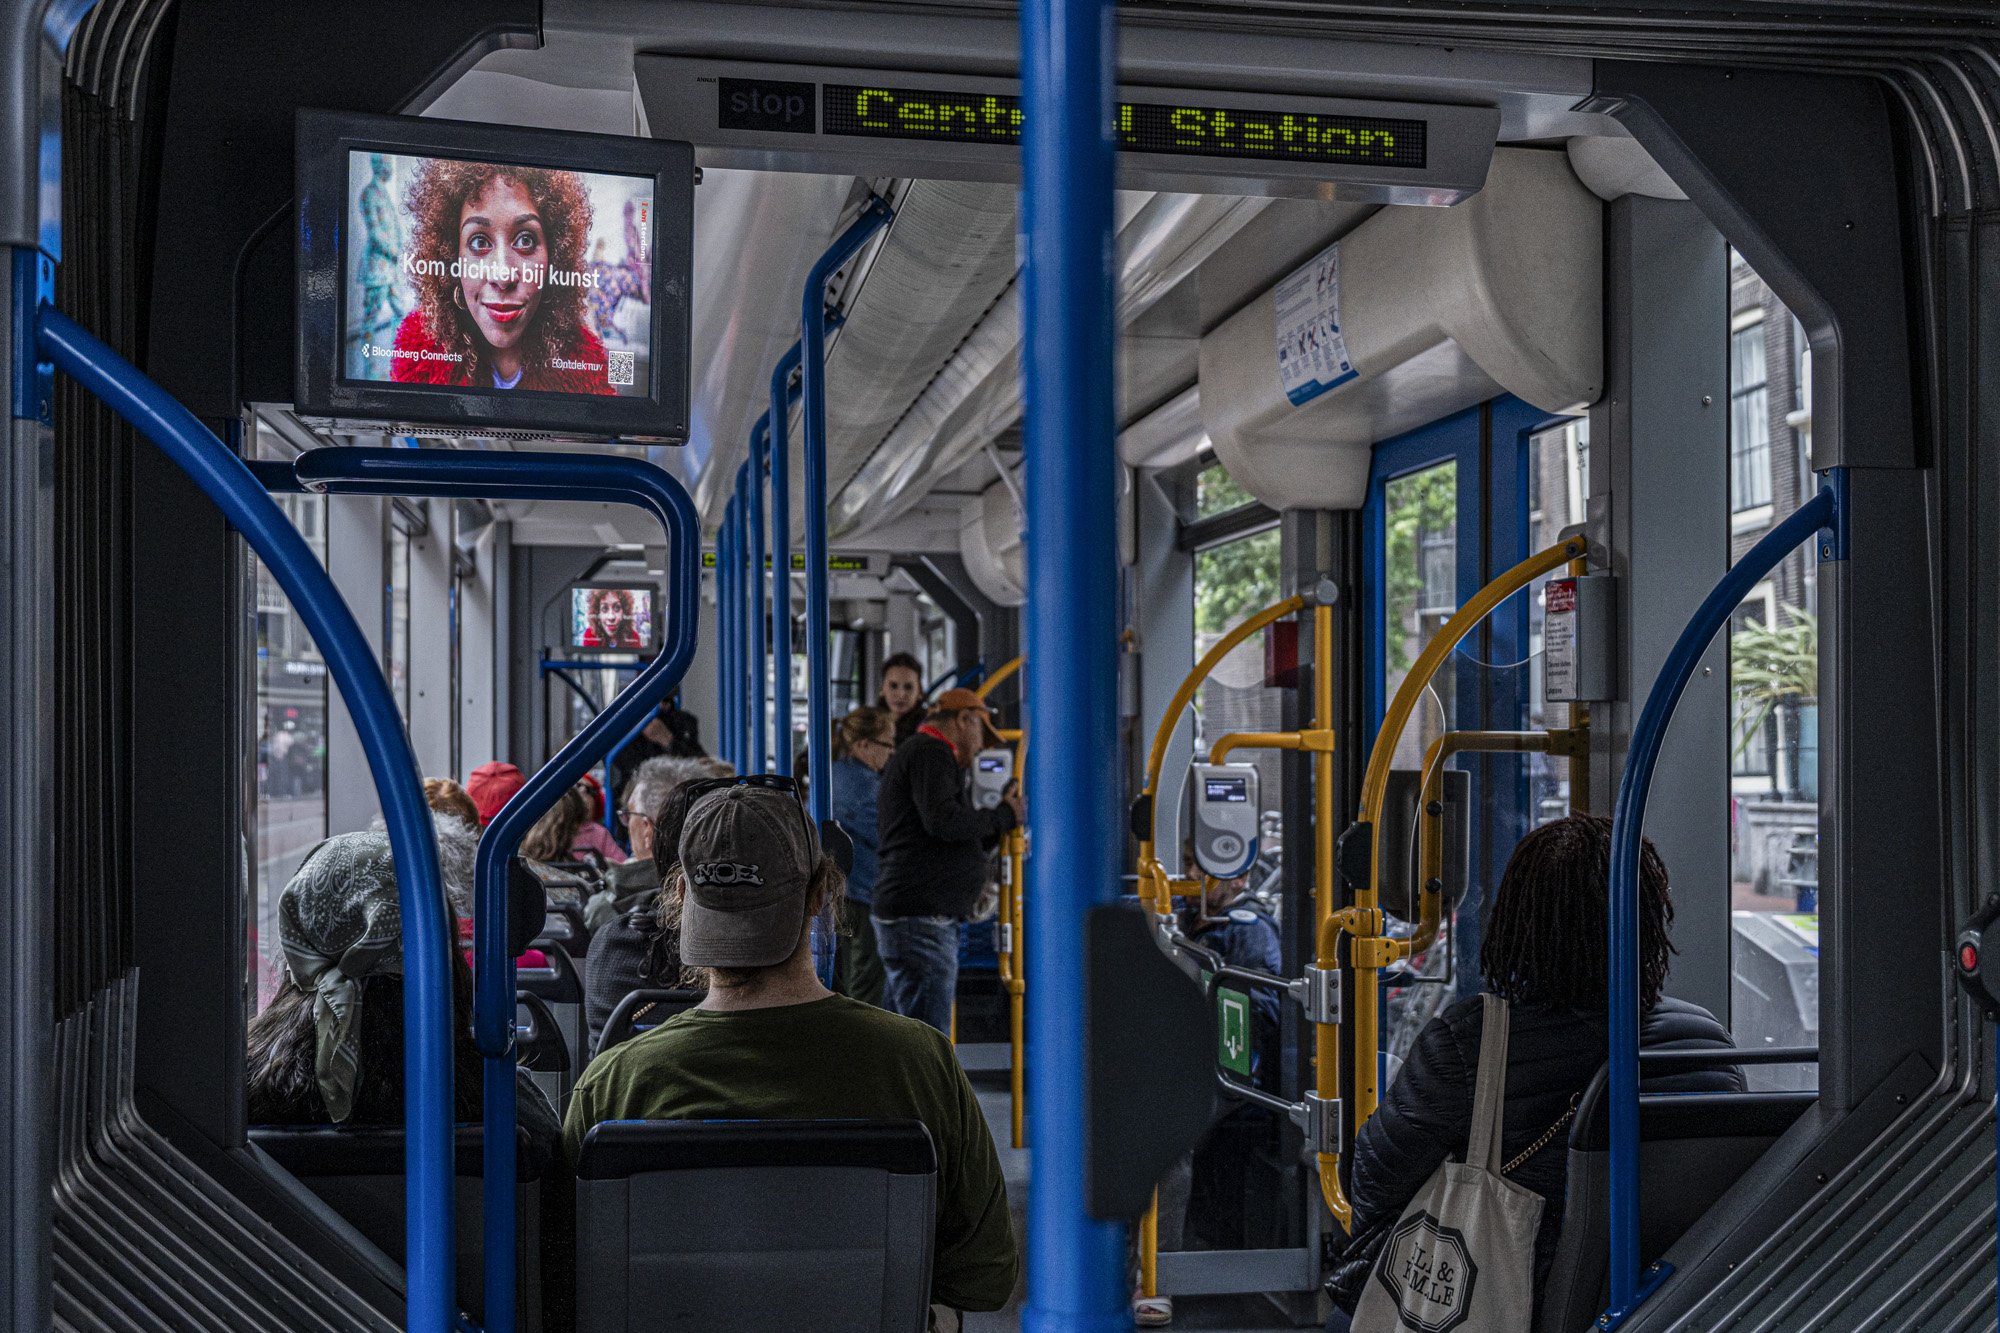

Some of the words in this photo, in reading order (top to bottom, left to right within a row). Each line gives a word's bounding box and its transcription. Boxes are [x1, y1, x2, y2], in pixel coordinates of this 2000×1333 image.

[731, 88, 805, 123] stop
[1170, 107, 1394, 158] Station
[403, 253, 445, 277] Kom
[450, 257, 519, 282] dichter
[522, 263, 546, 290] bij
[548, 265, 600, 289] kunst
[372, 346, 419, 362] Bloomberg
[420, 349, 463, 363] Connects
